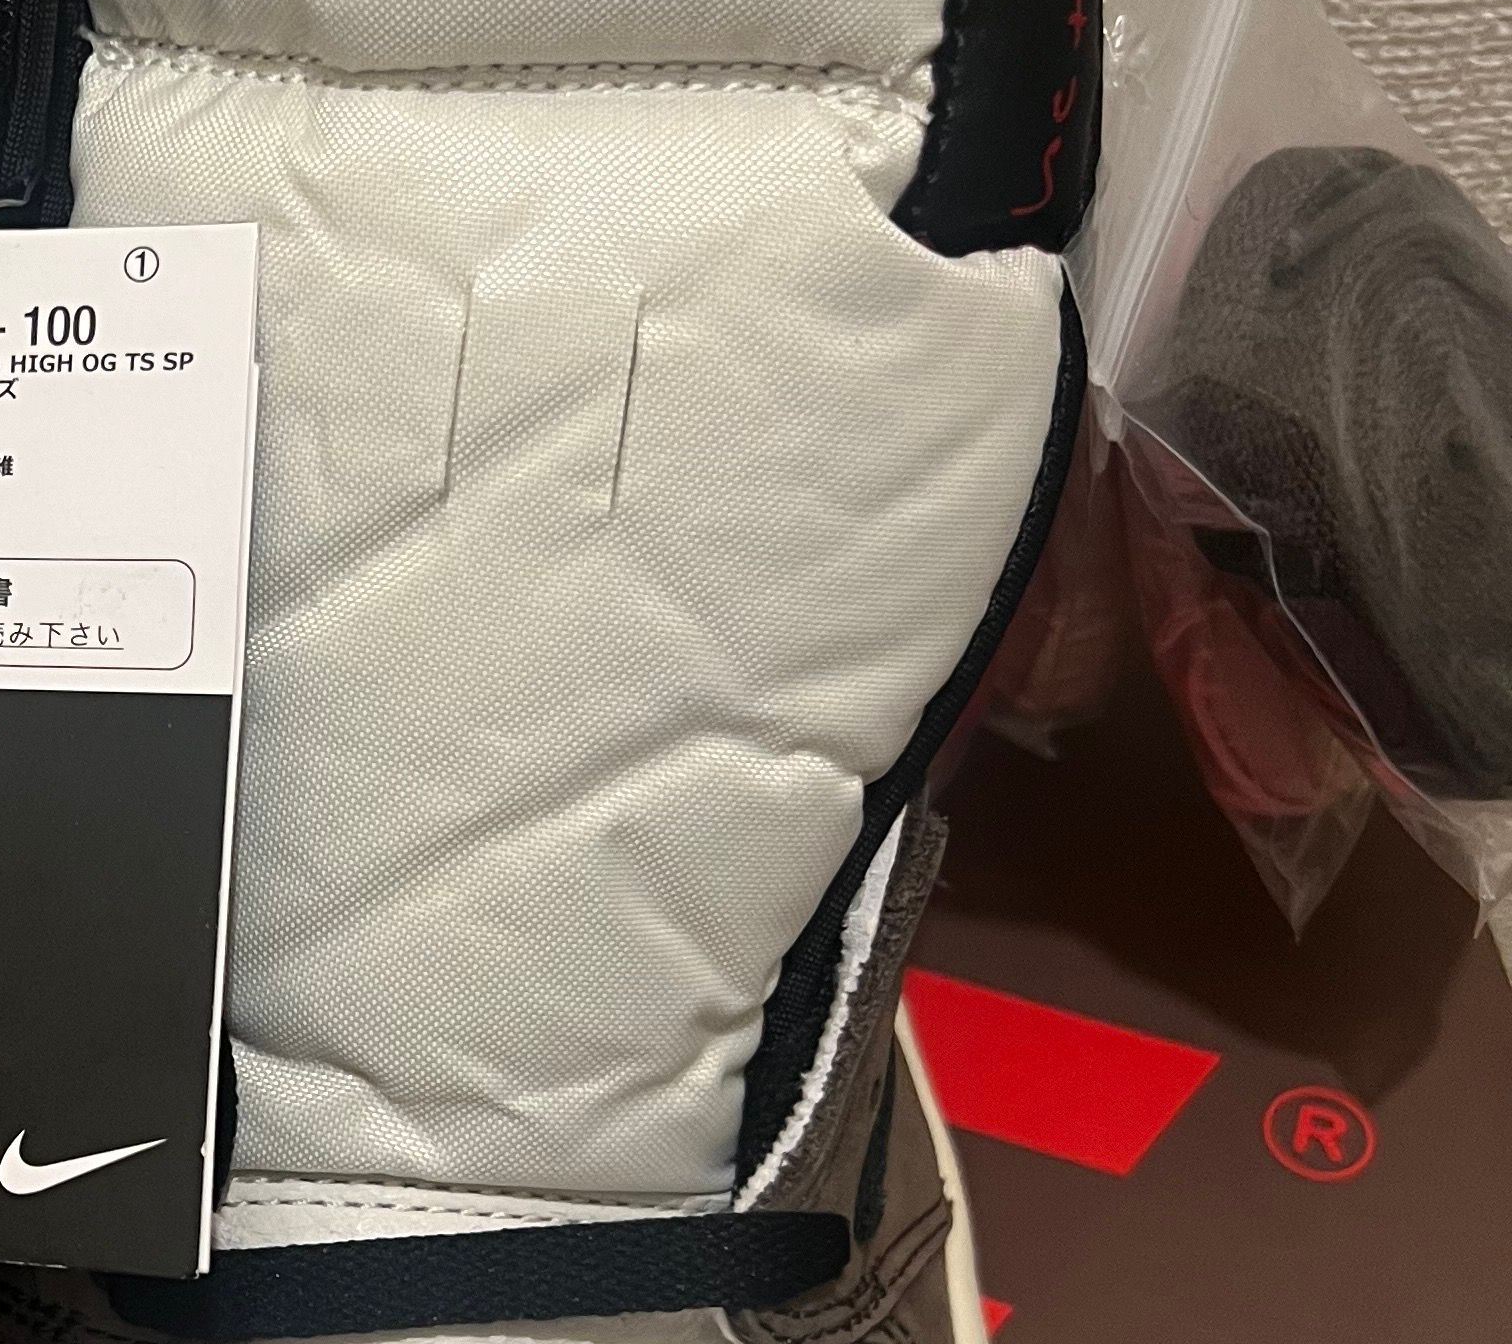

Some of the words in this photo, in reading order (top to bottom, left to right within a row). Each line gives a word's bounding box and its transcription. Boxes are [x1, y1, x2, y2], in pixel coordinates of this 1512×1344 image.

[24, 304, 97, 347] 100
[10, 354, 73, 374] HIGH
[82, 353, 117, 373] OG
[124, 353, 155, 372] TS
[162, 352, 194, 371] SP
